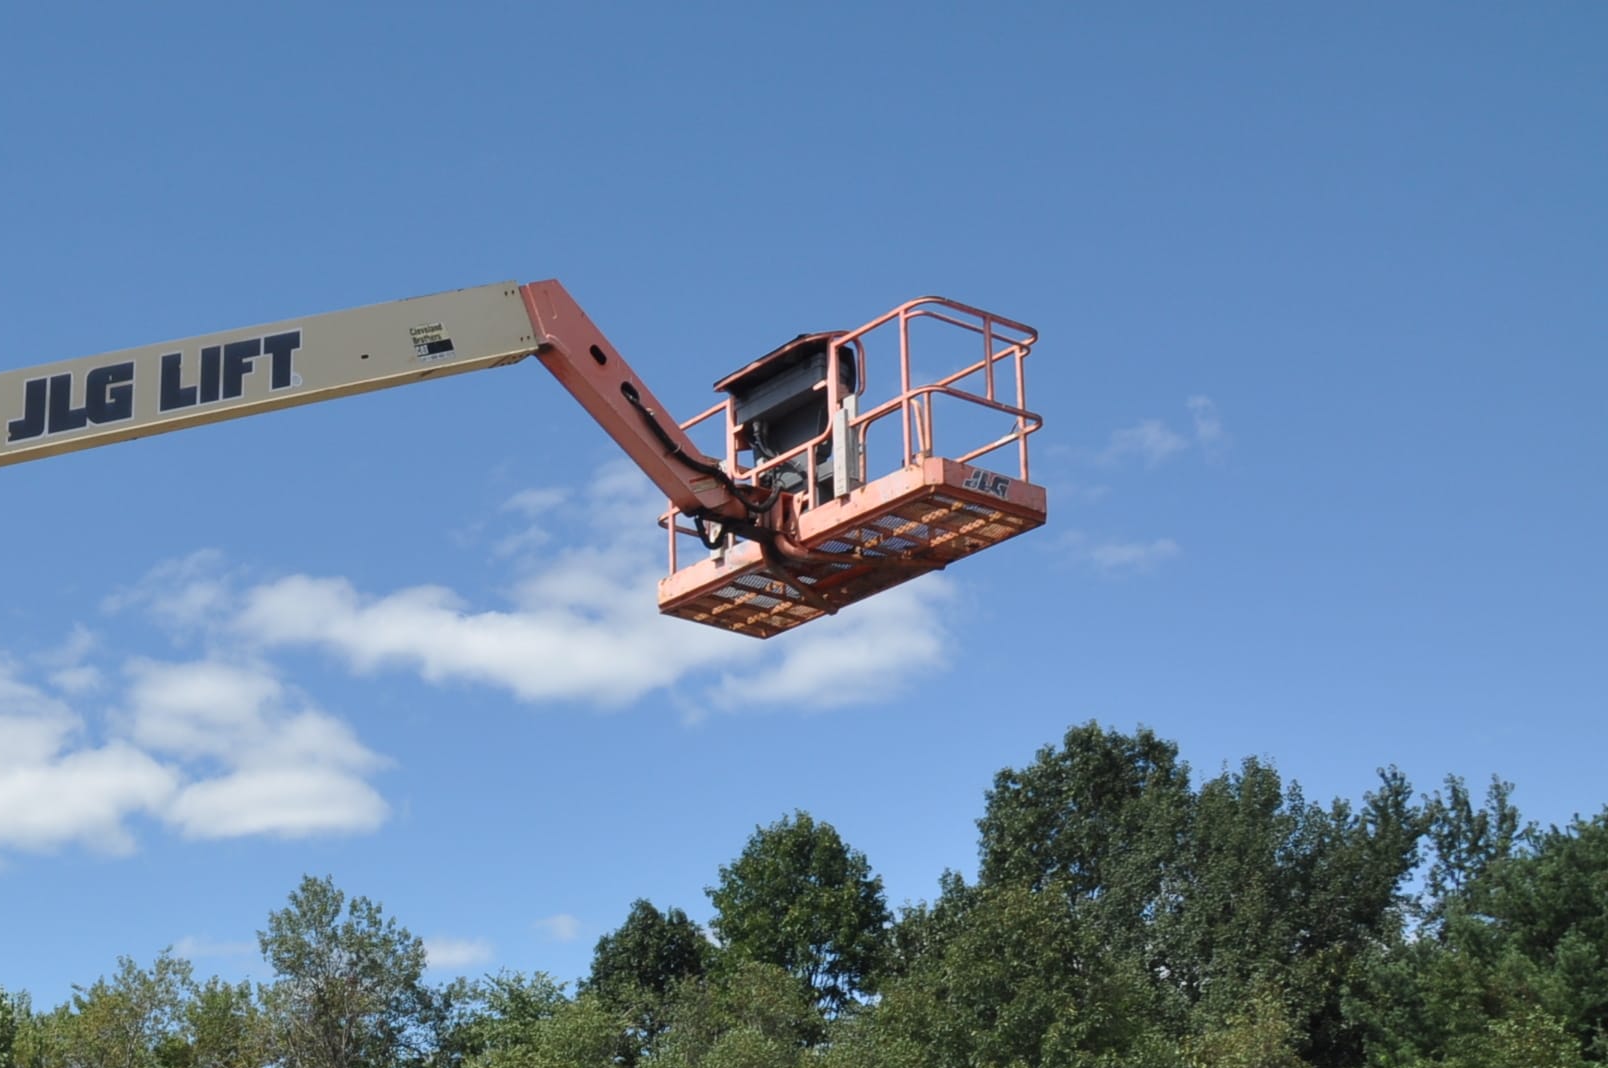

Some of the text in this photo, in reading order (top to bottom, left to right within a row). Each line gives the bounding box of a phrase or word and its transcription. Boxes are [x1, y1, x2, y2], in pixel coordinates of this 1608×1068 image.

[7, 329, 301, 443] JLG LIFT
[963, 470, 1010, 499] JLG
